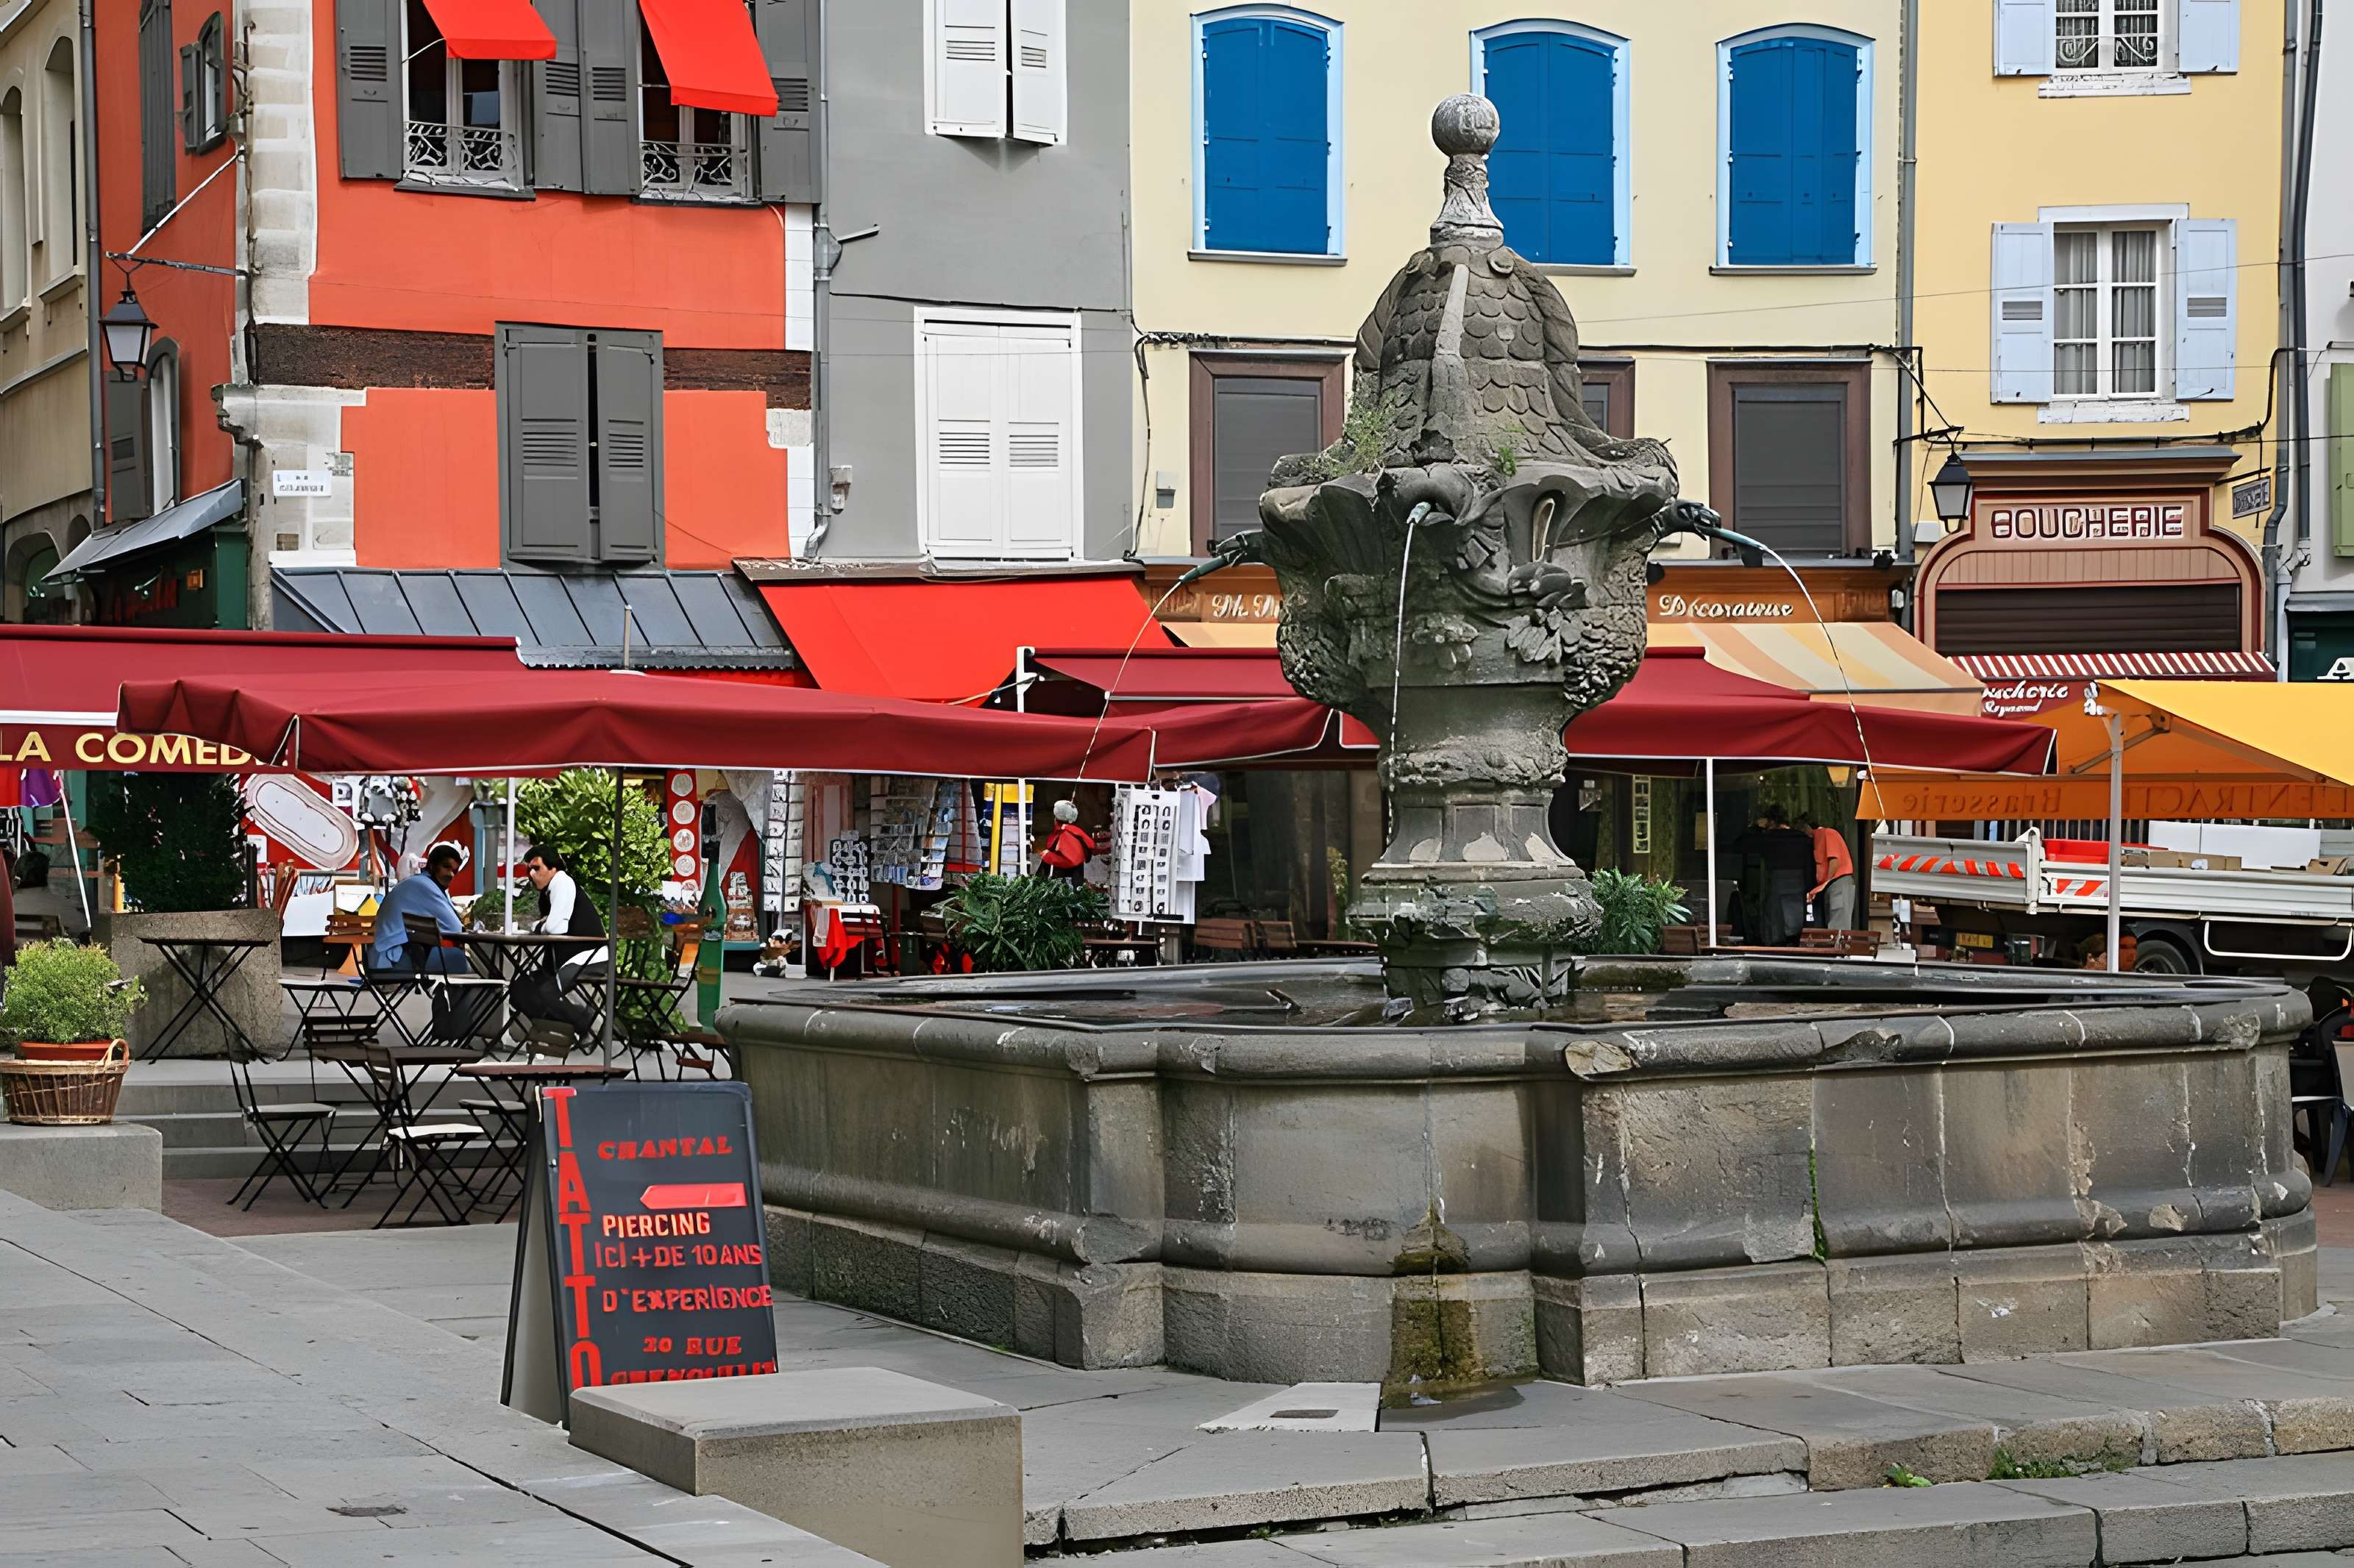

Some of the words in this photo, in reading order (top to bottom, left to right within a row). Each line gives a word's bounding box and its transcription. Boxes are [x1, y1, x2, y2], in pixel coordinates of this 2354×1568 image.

[1991, 505, 2183, 538] BOUCHERIE
[0, 731, 52, 762] LA
[75, 732, 288, 766] COMED
[597, 1135, 733, 1161] CHANTAL
[602, 1212, 711, 1239] PIERCING
[642, 1336, 672, 1353] 20
[686, 1336, 742, 1356] RUE
